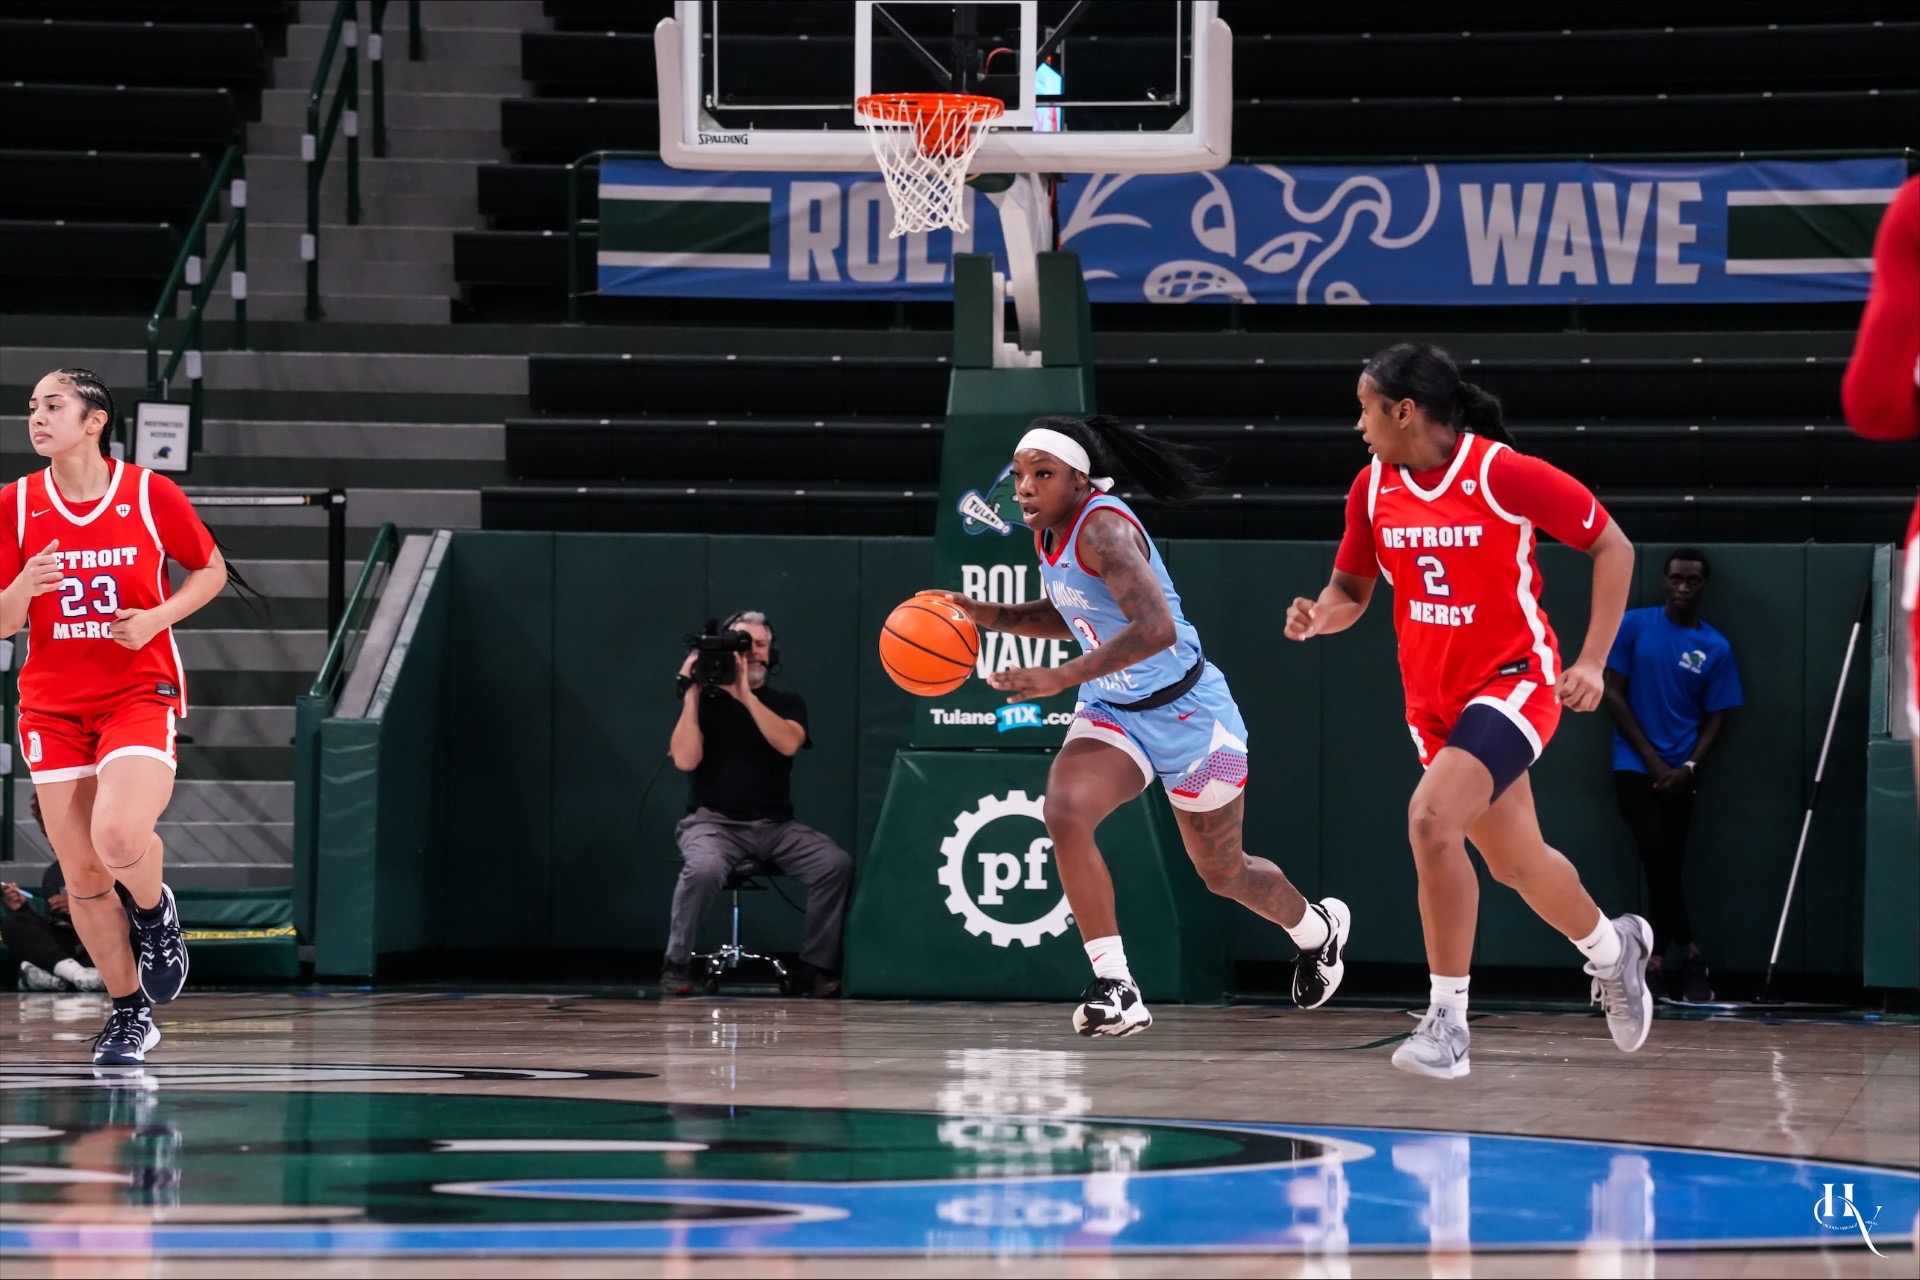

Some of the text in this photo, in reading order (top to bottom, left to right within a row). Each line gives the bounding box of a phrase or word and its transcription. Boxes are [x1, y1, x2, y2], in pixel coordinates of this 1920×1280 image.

[698, 134, 748, 145] SPALDING
[1459, 181, 1702, 286] WAVE
[1381, 525, 1483, 549] DETROIT
[52, 546, 138, 570] ETROIT
[1415, 555, 1451, 597] 2
[57, 574, 120, 618] 23
[1408, 599, 1477, 627] MERCY
[52, 620, 114, 640] MERC
[930, 705, 1075, 726] TulaneTIX.co
[978, 837, 1053, 905] pf
